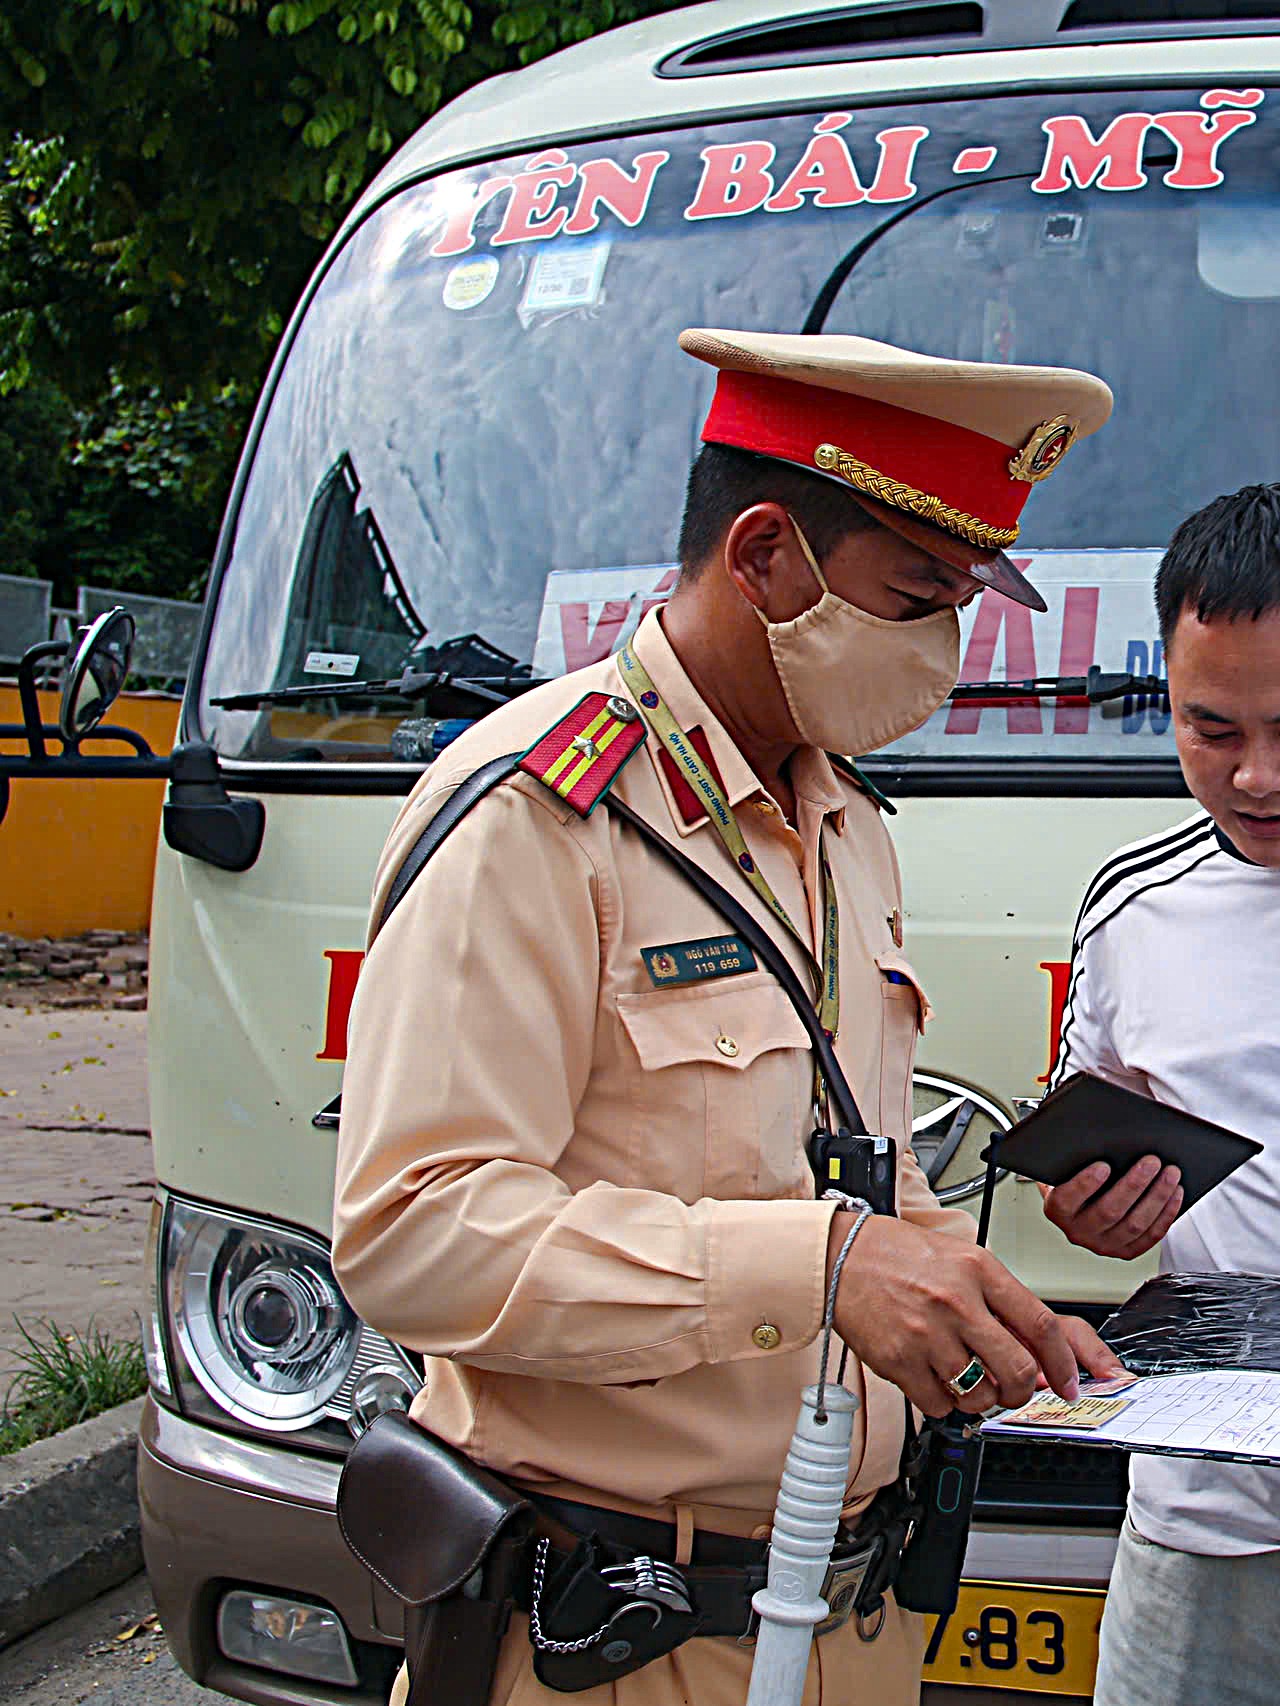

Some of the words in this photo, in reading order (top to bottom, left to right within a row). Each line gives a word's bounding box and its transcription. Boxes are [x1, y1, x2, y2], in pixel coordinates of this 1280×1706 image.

[429, 147, 671, 258] YÊN
[683, 112, 930, 221] BÁI
[952, 146, 998, 175] -
[1031, 88, 1265, 193] MỸ
[698, 778, 715, 798] CSGT
[695, 961, 716, 974] 119
[720, 957, 741, 970] 659
